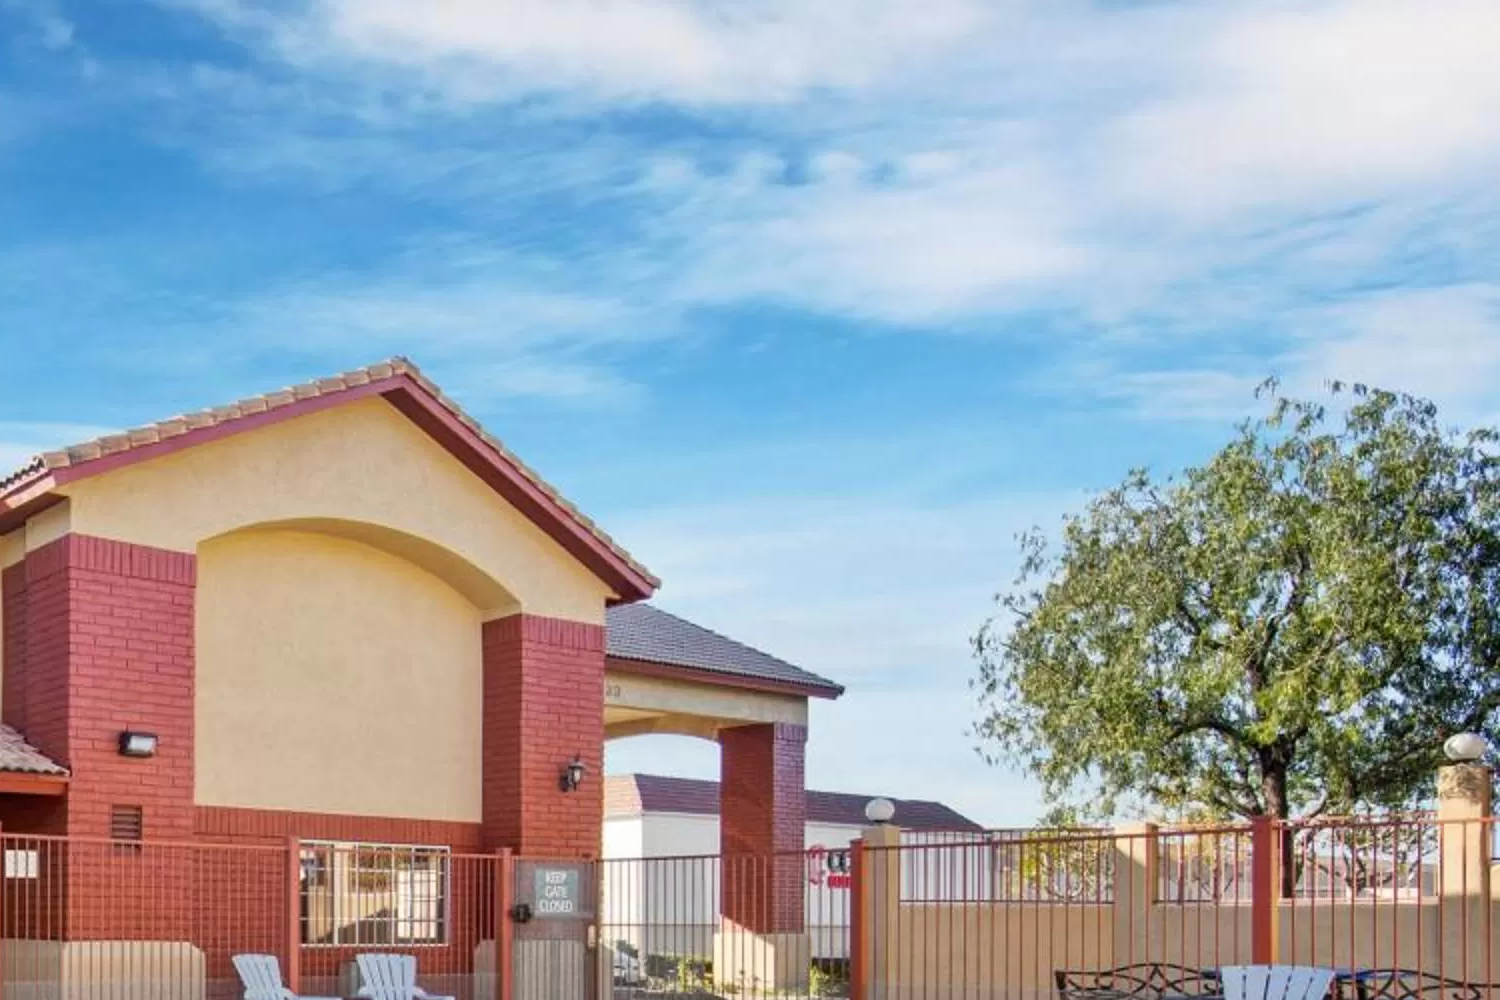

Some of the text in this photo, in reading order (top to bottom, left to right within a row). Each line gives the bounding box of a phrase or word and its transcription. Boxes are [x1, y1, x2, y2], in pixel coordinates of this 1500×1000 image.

[545, 871, 567, 884] KEEP
[544, 885, 568, 898] GATE
[539, 899, 573, 913] CLOSED
